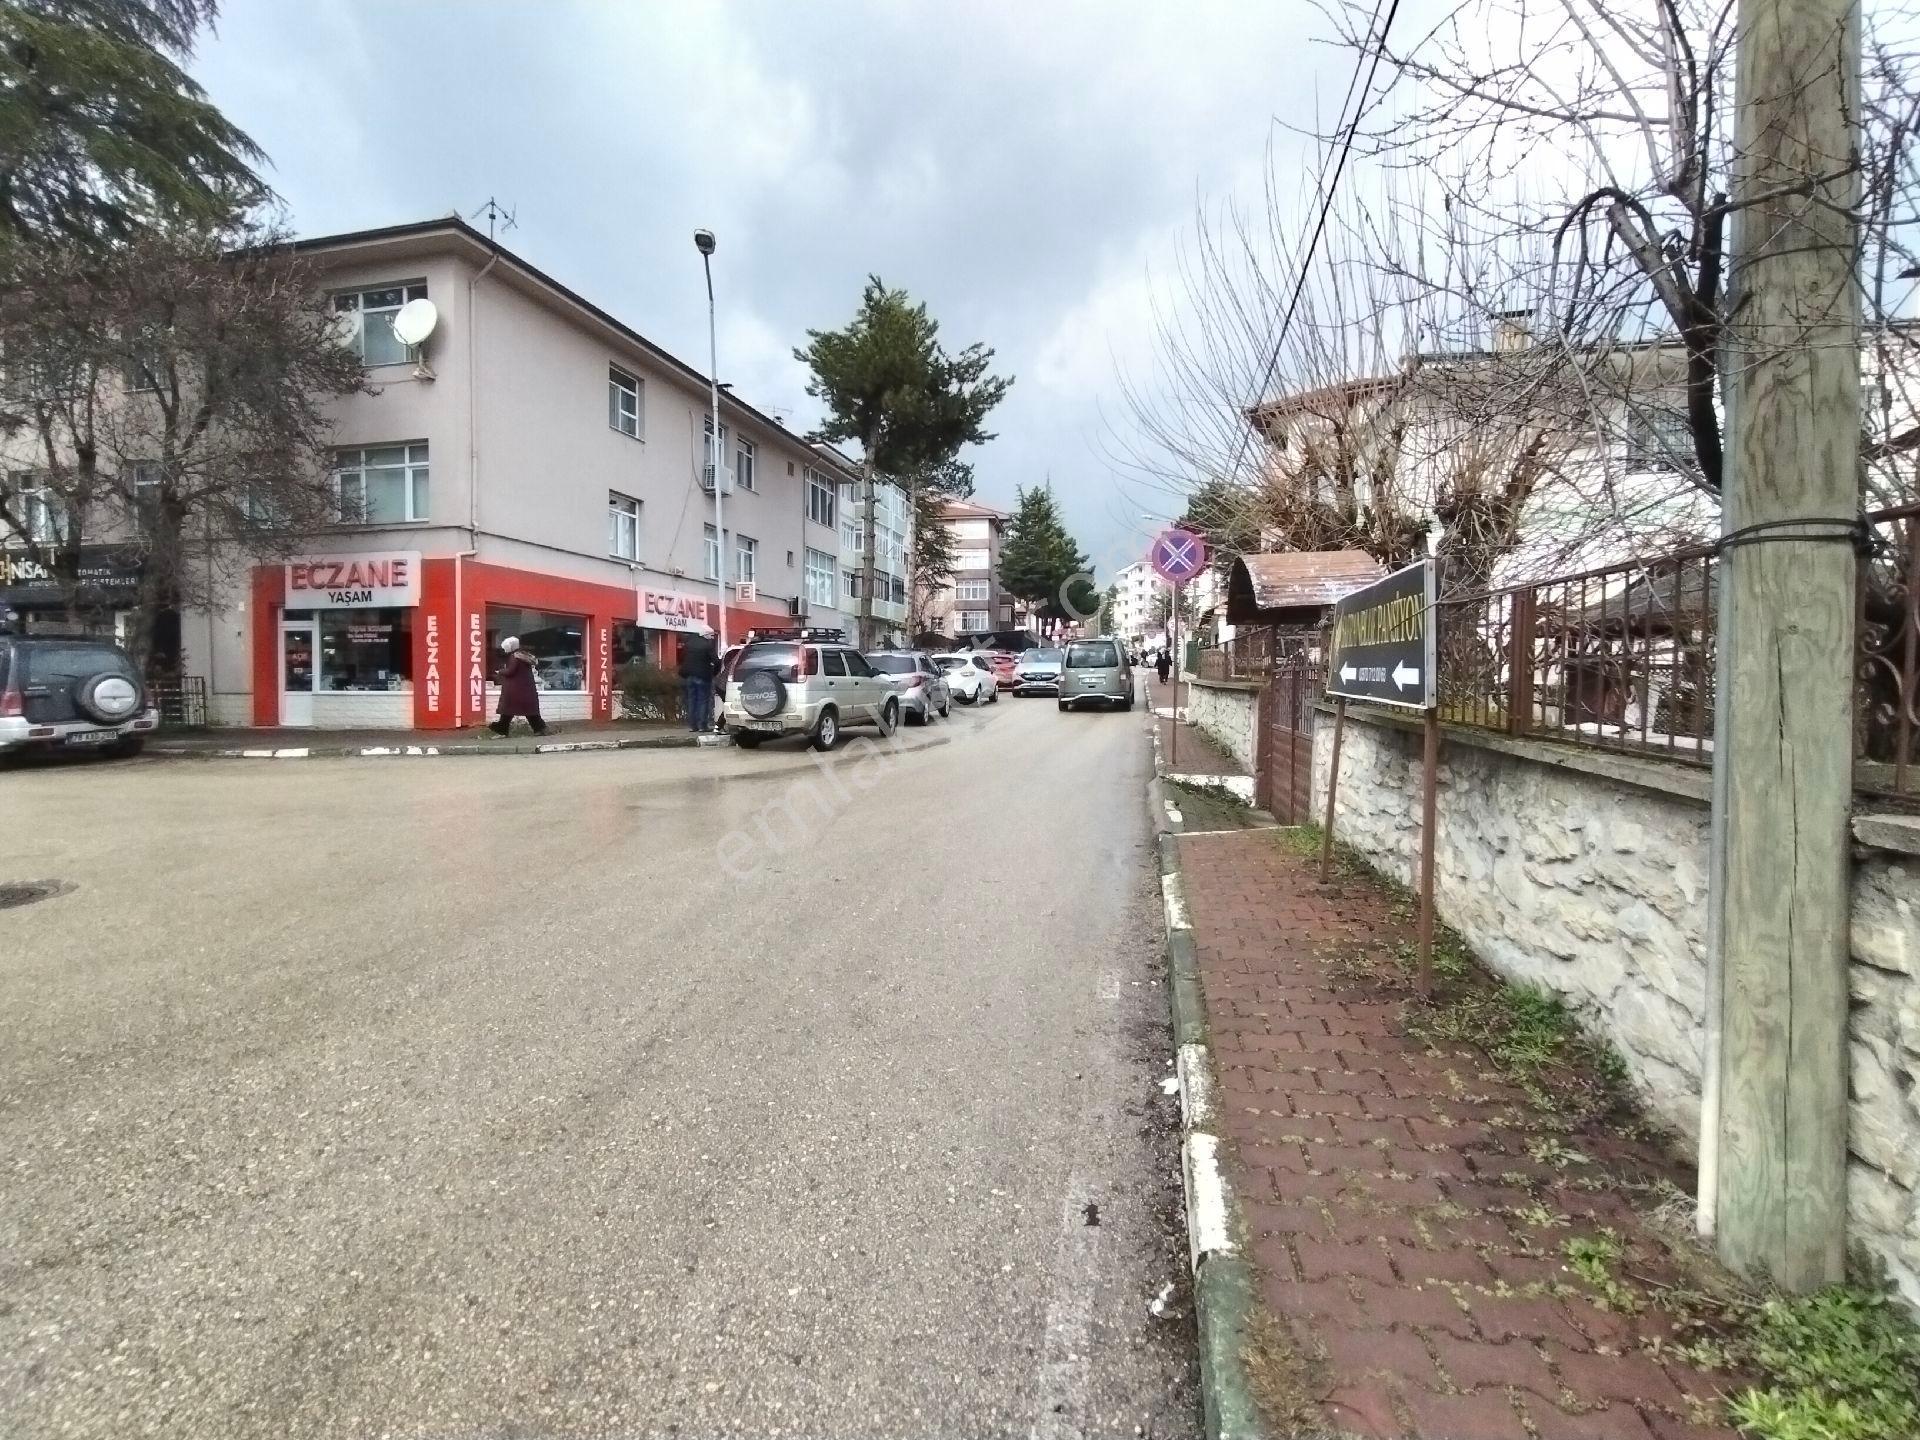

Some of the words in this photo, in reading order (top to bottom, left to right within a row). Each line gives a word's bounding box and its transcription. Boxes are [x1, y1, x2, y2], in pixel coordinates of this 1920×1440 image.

[291, 559, 408, 590] ECZANE
[328, 590, 373, 606] YAŞAM
[644, 591, 705, 620] ECZANE
[740, 586, 750, 599] E
[665, 616, 688, 629] YAŞAM
[426, 615, 440, 712] ECZANE
[469, 613, 483, 711] ECZANE
[600, 629, 609, 711] ECZANE
[741, 691, 777, 701] TERIOS
